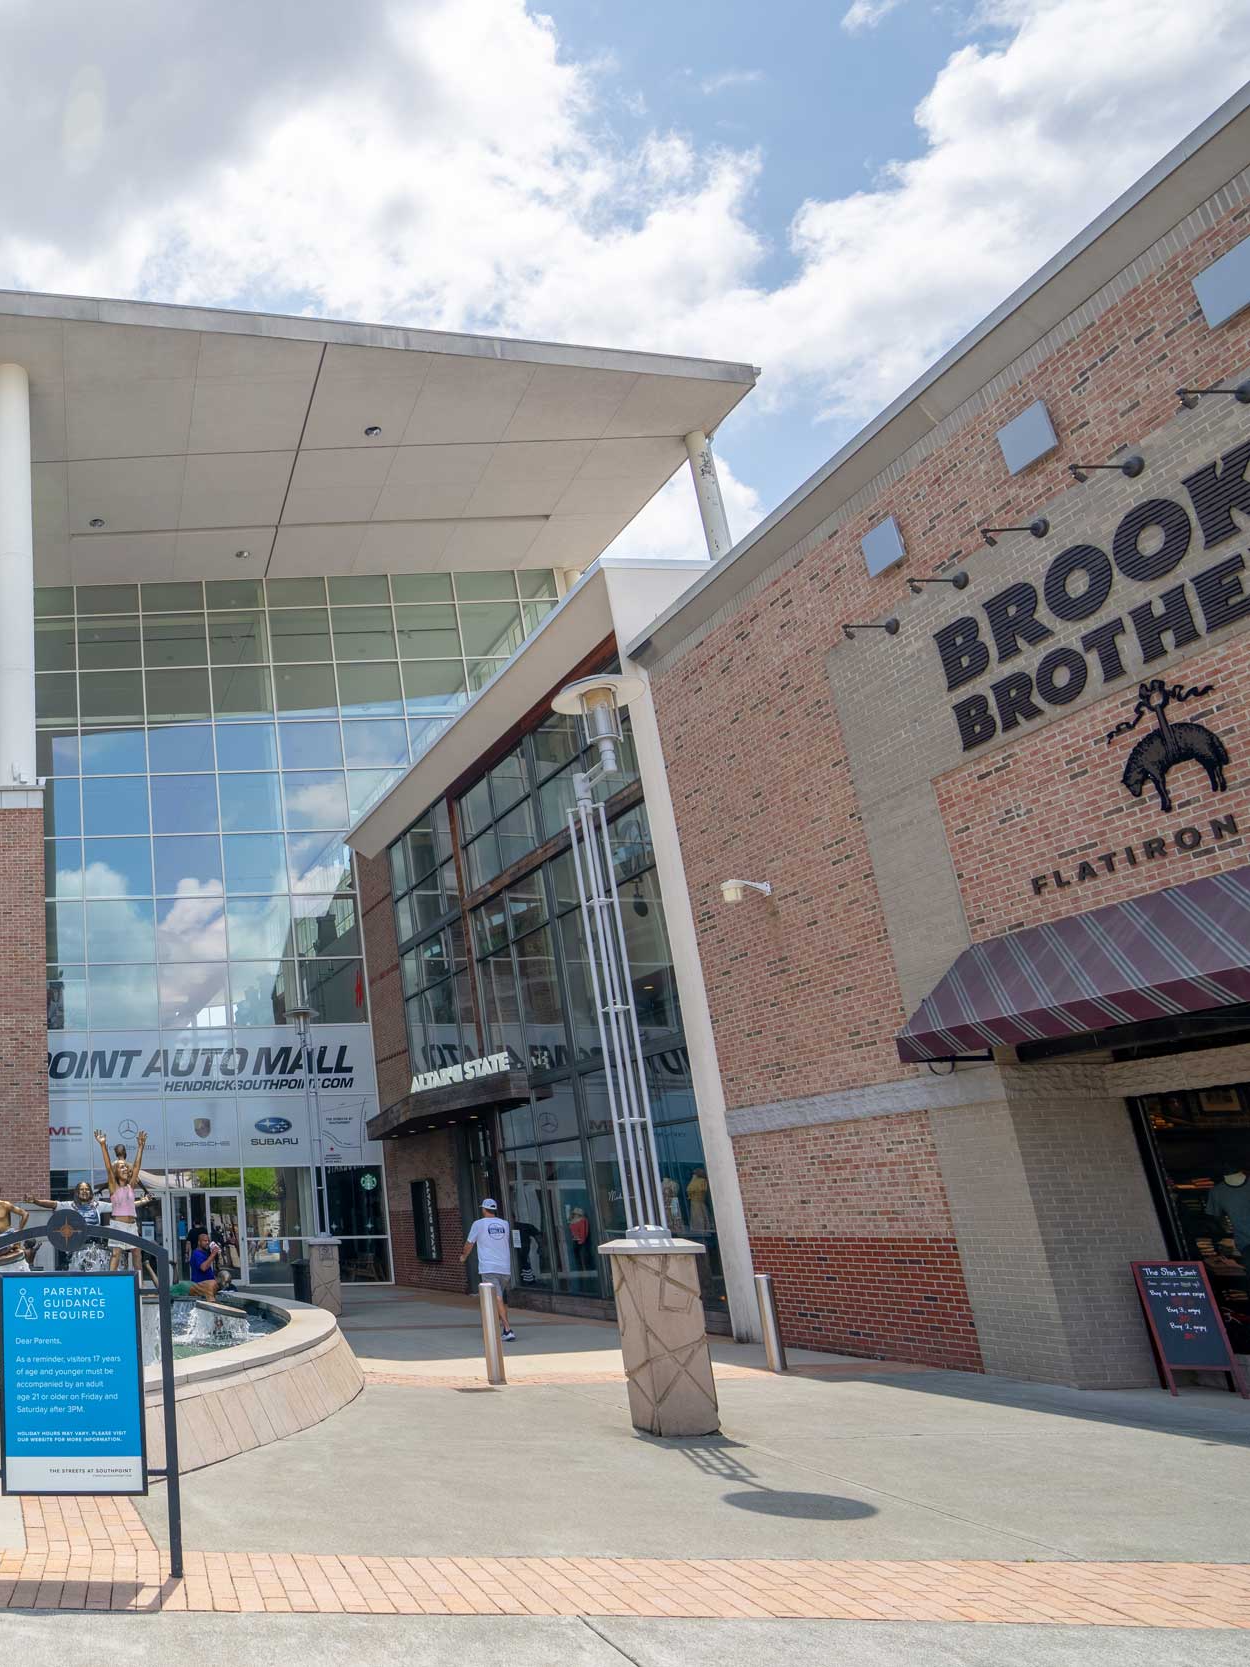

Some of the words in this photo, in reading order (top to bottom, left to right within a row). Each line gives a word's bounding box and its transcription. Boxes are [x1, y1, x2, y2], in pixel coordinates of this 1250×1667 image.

[1031, 814, 1239, 896] FLATIRON
[141, 1047, 249, 1078] AUTO
[252, 1045, 354, 1076] MALL
[463, 1051, 511, 1080] STATE
[48, 1126, 83, 1136] MC
[250, 1137, 299, 1146] SUBARU
[43, 1287, 103, 1296] PARENTAL
[43, 1299, 106, 1308] GUIDANCE
[44, 1311, 105, 1320] REQUIRED
[15, 1337, 32, 1345] Dear
[16, 1355, 24, 1363] As
[32, 1355, 66, 1364] reminder,
[67, 1355, 91, 1363] visitors
[101, 1356, 121, 1364] years
[55, 1369, 83, 1377] younger
[16, 1381, 64, 1389] accompanied
[64, 1381, 73, 1389] by
[16, 1394, 30, 1402] age
[81, 1392, 103, 1402] Friday
[16, 1405, 48, 1415] Saturday
[49, 1405, 65, 1413] after
[67, 1405, 85, 1413] 3PM.
